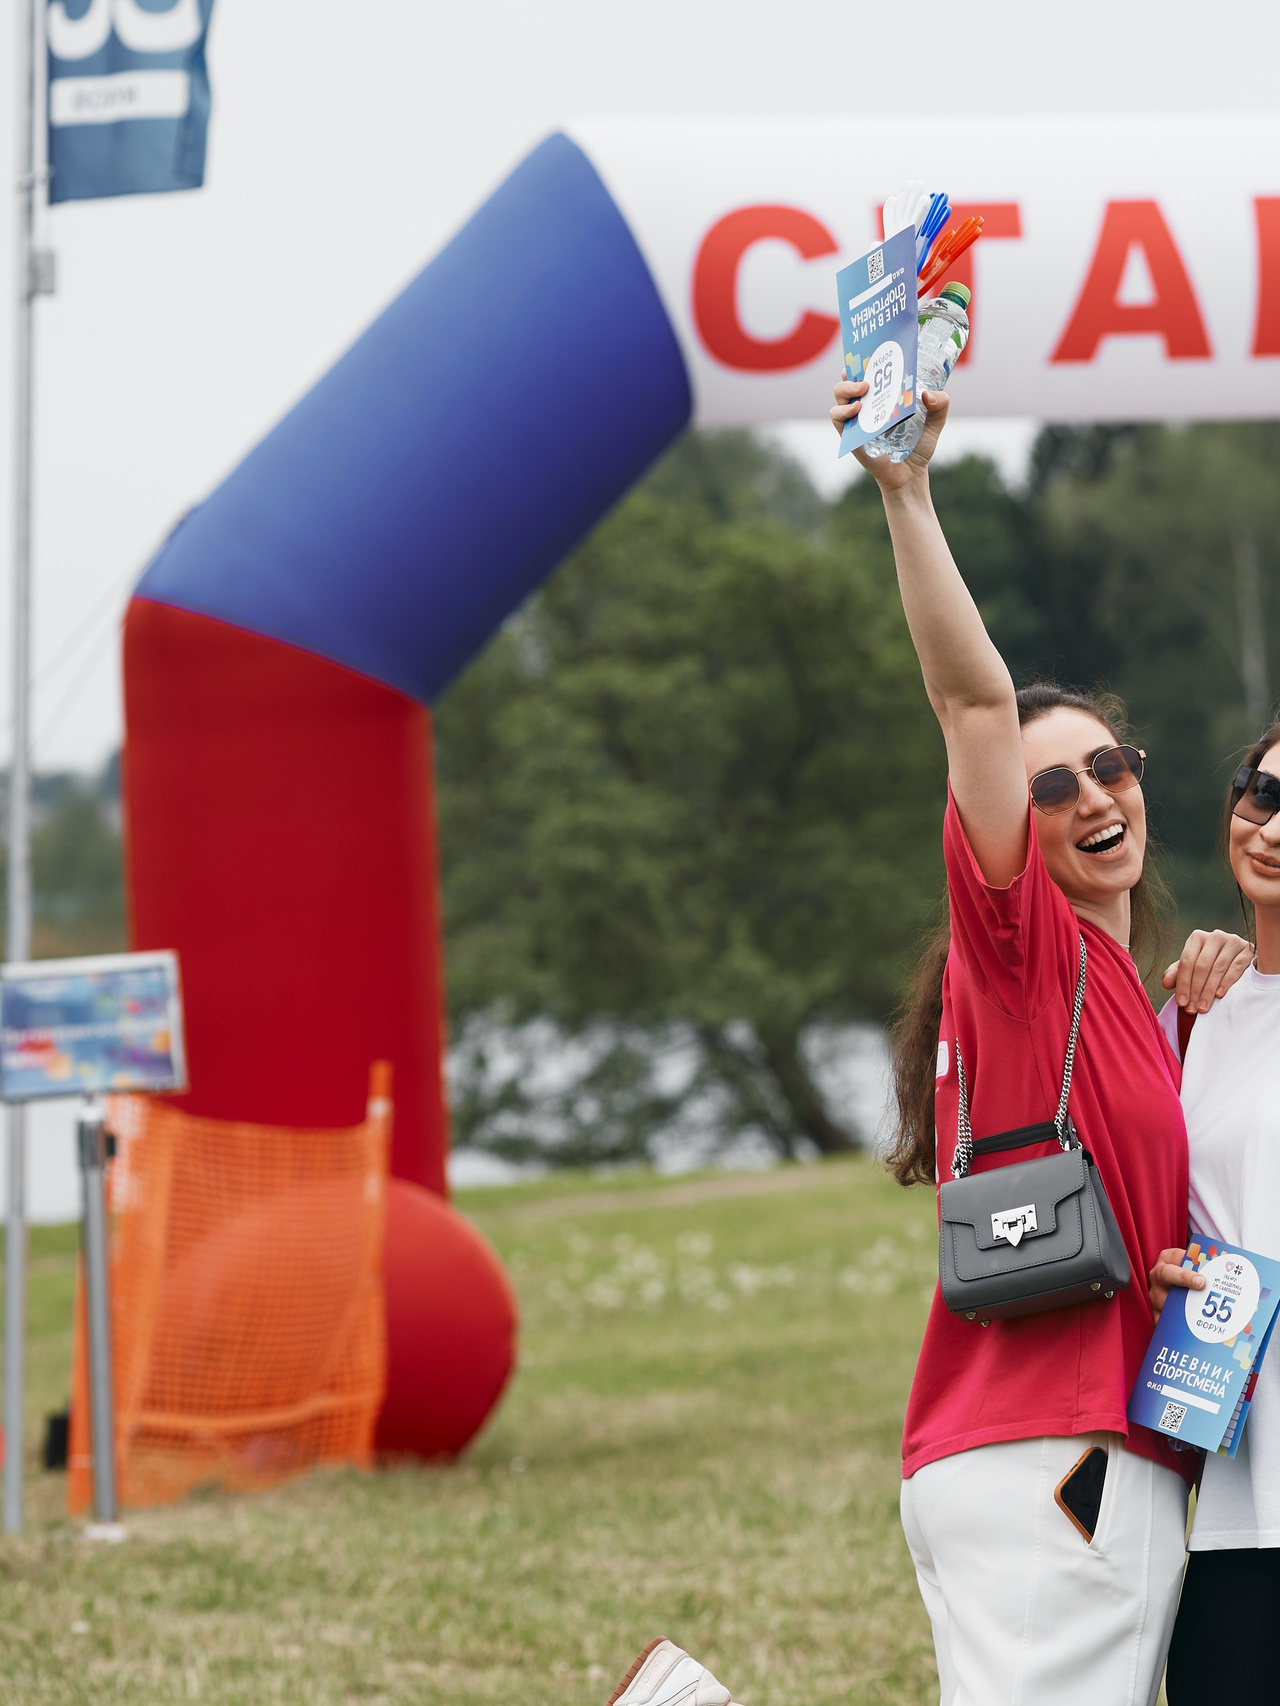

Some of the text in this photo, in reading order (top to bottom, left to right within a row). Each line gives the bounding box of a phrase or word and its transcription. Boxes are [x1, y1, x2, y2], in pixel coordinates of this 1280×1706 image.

[850, 282, 906, 328] СПОРТСМЕНА
[852, 295, 907, 344] ДНЕВНИК
[873, 361, 894, 396] 55
[1201, 1290, 1237, 1324] 55
[1196, 1319, 1227, 1335] ФОРУМ
[1152, 1361, 1227, 1399] СПОРТСМЕНА
[1156, 1346, 1234, 1384] ДНЕВНИК
